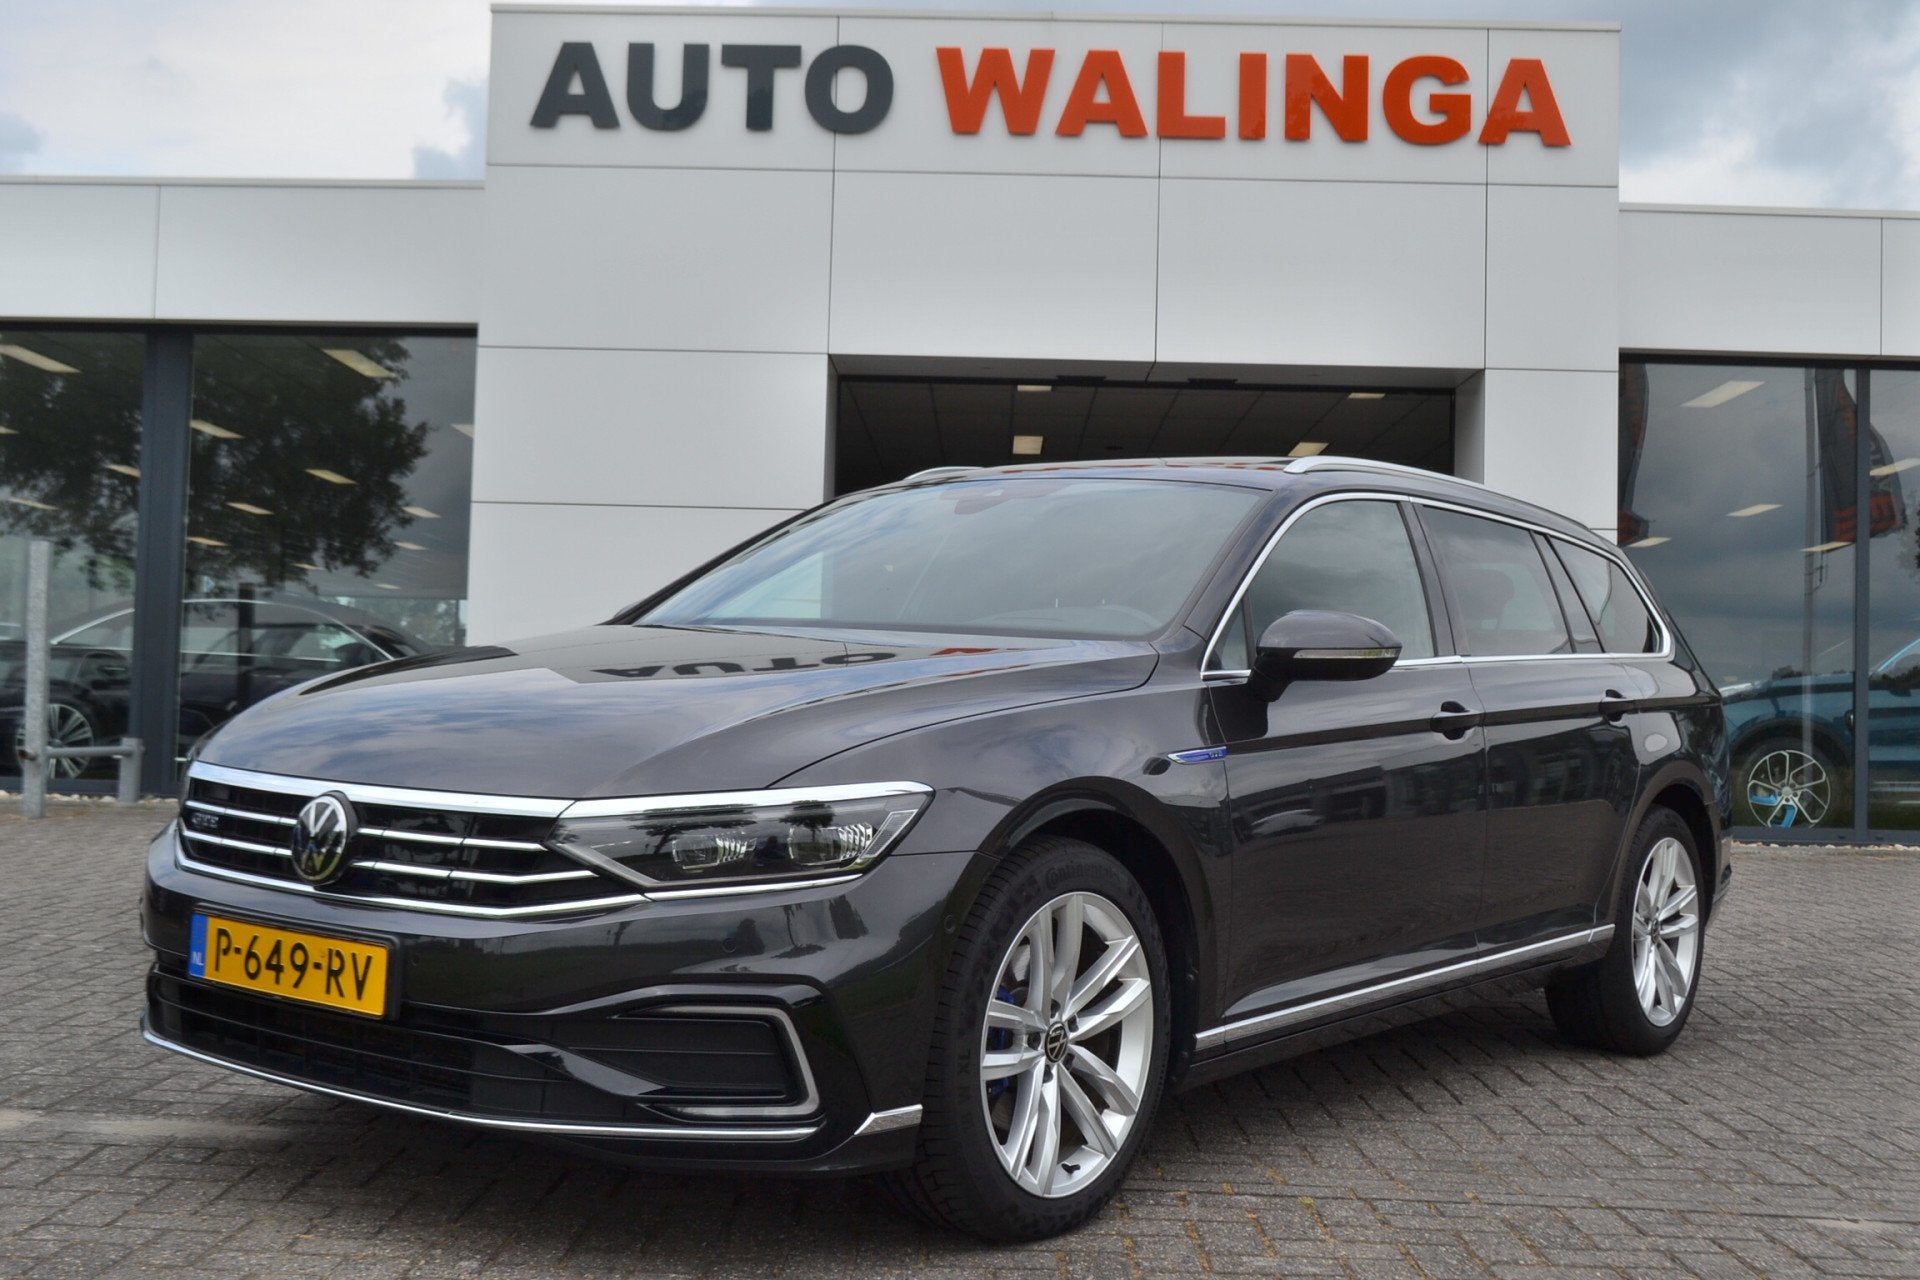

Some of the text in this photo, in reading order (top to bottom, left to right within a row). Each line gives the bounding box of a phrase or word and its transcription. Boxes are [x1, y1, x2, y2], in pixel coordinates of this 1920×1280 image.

[529, 41, 1571, 147] AUTO WALINGA
[192, 950, 204, 966] NL
[214, 927, 374, 1001] P-649-RV
